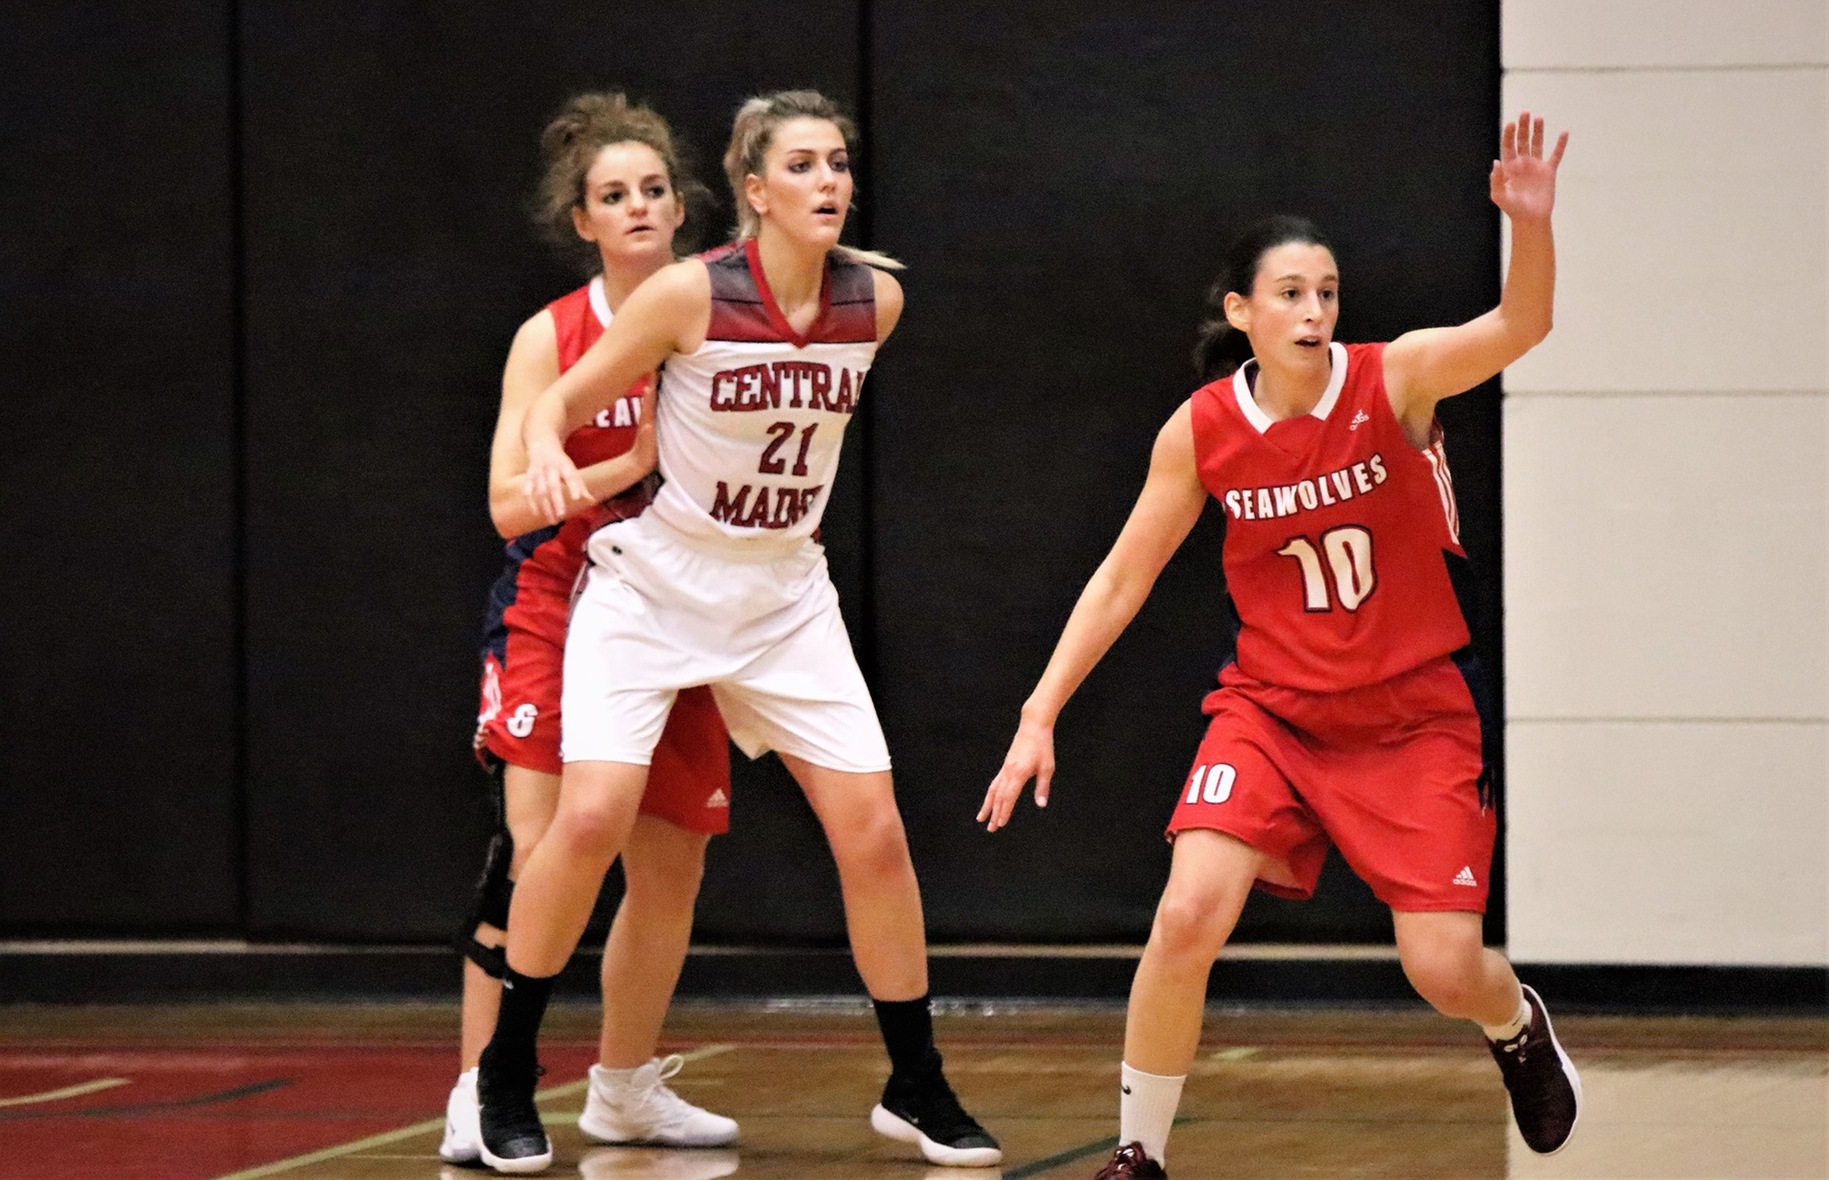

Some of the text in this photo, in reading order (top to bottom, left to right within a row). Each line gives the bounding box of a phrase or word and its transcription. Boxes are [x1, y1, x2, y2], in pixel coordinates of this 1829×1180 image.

[758, 421, 819, 477] 21
[1224, 453, 1388, 521] SEAWOLVES
[1276, 523, 1378, 614] 10
[506, 702, 539, 739] 6
[1185, 762, 1237, 805] 10
